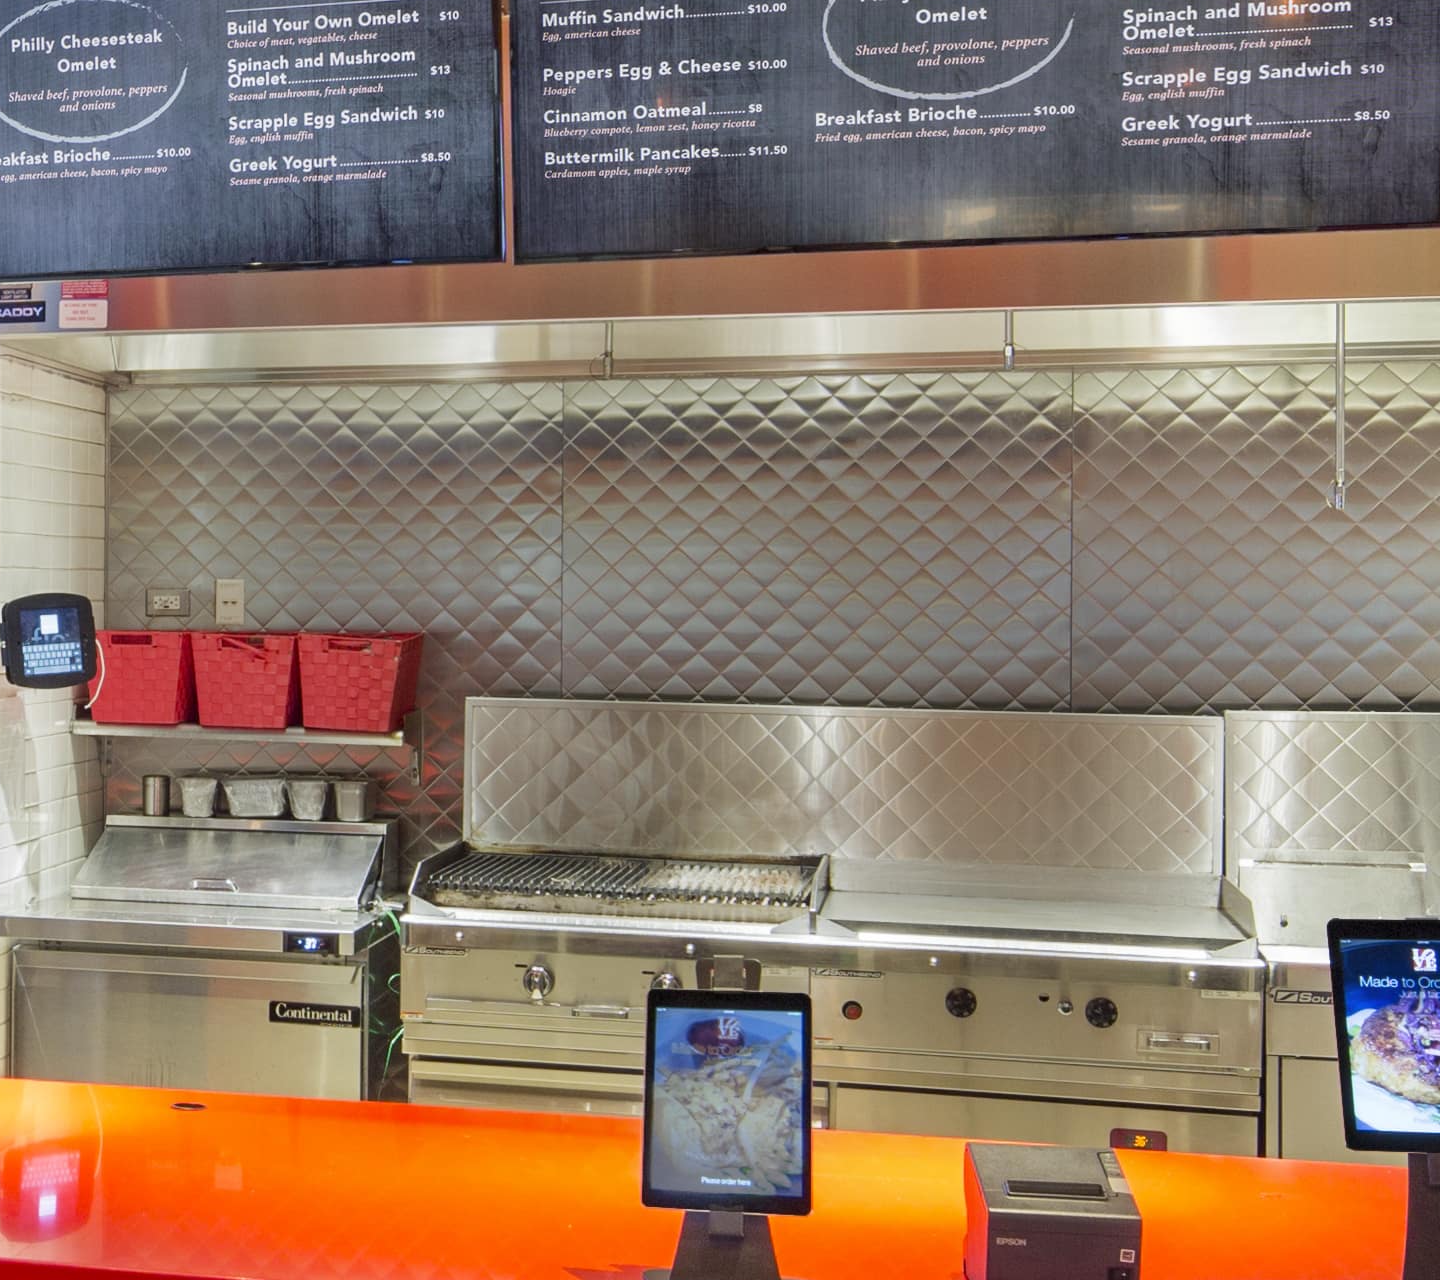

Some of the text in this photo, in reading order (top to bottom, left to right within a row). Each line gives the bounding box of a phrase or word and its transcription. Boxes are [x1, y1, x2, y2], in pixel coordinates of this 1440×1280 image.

[228, 9, 459, 36] Build Your Own Omelet $10
[916, 7, 987, 24] Omelet
[11, 29, 162, 54] Philly Cheesesteak
[57, 57, 116, 72] Omelet
[228, 50, 416, 74] Spinach and Mushroom
[431, 65, 450, 76] $13
[9, 84, 168, 102] Shaved beef, provolone, peppers
[60, 101, 116, 113] and onions
[229, 106, 444, 132] Scrapple Egg Sandwich $10
[54, 147, 110, 163] Brioche
[156, 147, 191, 158] $10.00
[230, 152, 451, 173] Greek Yogurt $8.50
[1359, 976, 1398, 988] Made
[1402, 977, 1415, 988] to
[274, 1002, 352, 1024] Continental
[996, 1238, 1027, 1247] EPSON
